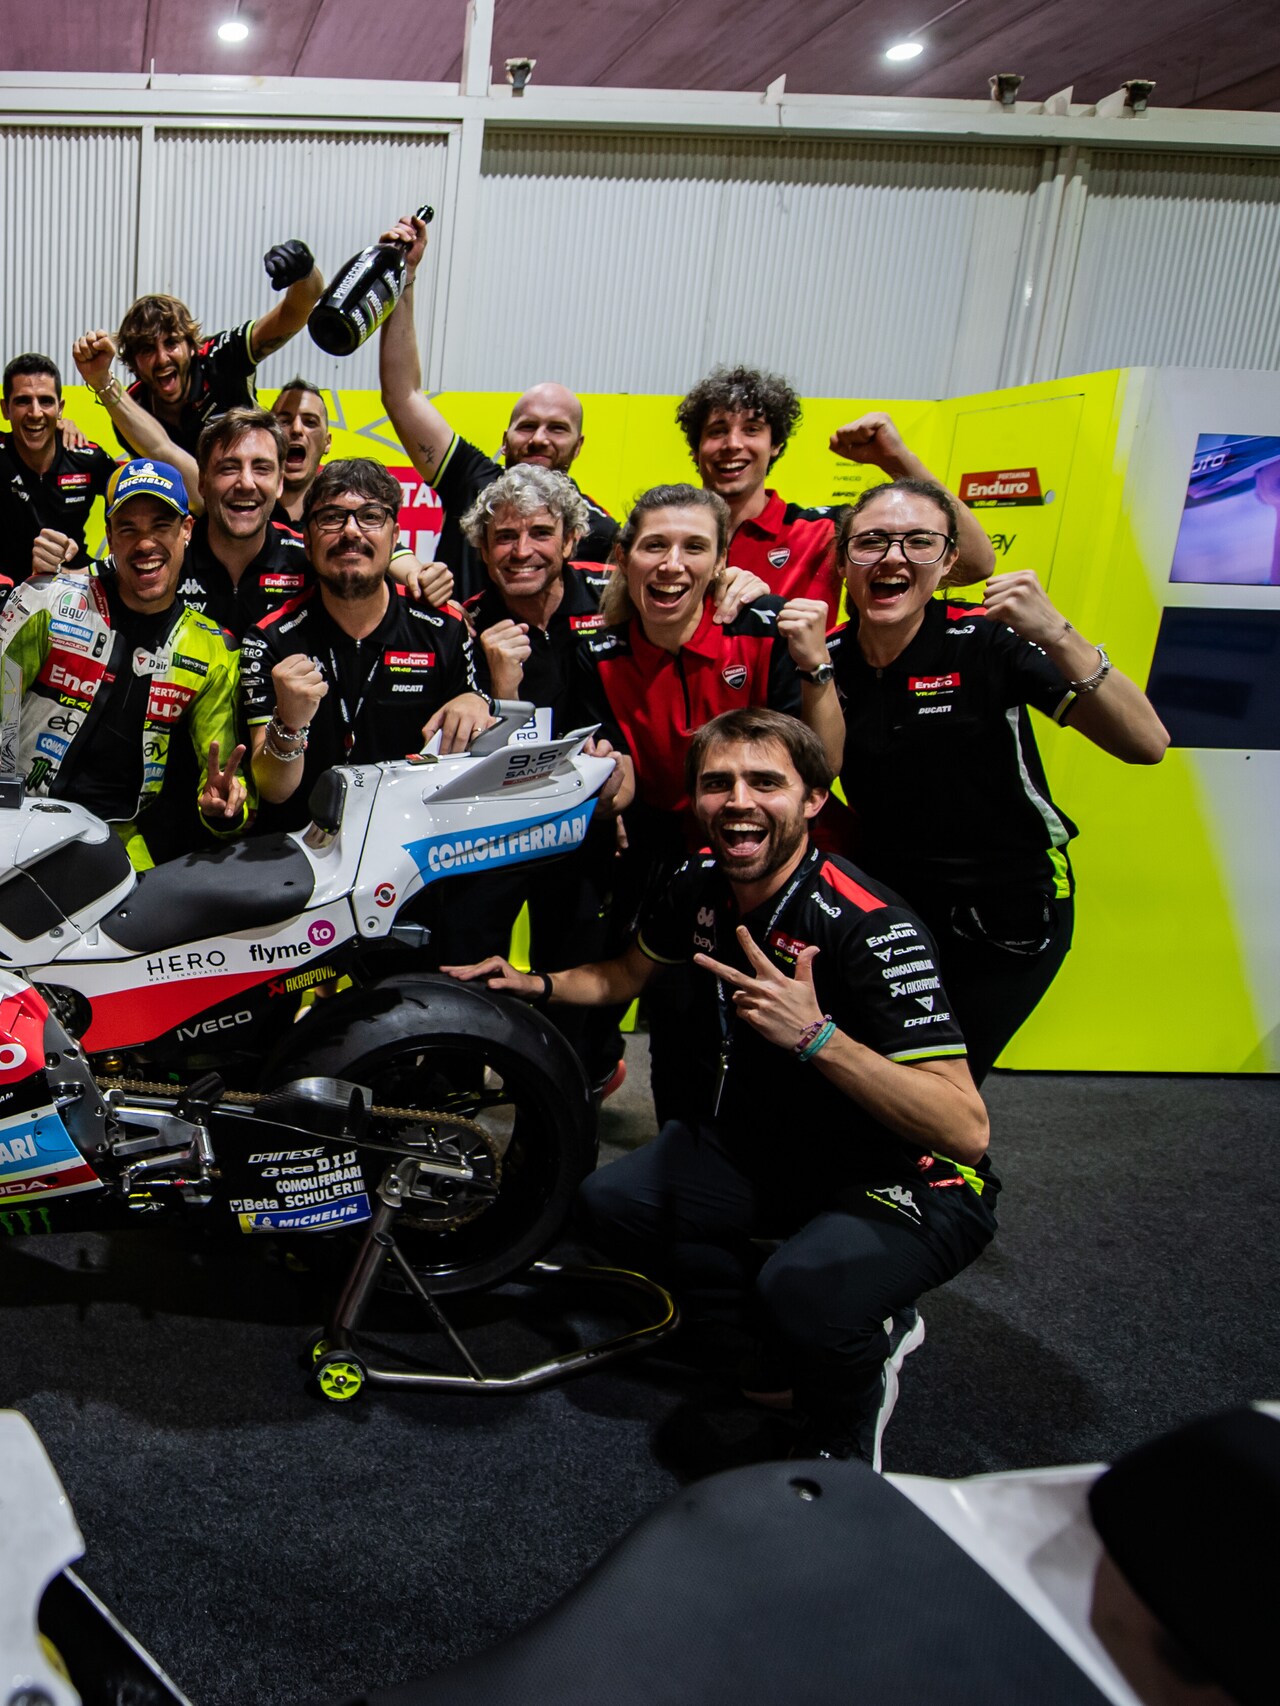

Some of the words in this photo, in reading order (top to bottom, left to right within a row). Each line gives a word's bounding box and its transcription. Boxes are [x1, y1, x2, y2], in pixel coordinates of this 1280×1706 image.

[118, 477, 173, 491] MICHELIN
[967, 480, 1029, 497] Enduro
[991, 533, 1017, 555] ay
[264, 577, 300, 587] Enduro
[61, 605, 84, 620] agv
[184, 599, 207, 613] bay
[390, 655, 429, 665] Enduro
[391, 684, 424, 693] DUCATI
[918, 705, 952, 715] DUCATI
[428, 836, 507, 872] COMOLI
[509, 814, 587, 855] FERRARI
[311, 926, 332, 942] to
[693, 931, 715, 952] bay
[866, 928, 918, 948] Enduro
[249, 941, 312, 964] flyme
[893, 945, 926, 956] CUPRA
[147, 950, 226, 976] HERO
[882, 963, 912, 979] COMOLI
[176, 968, 229, 978] INNOVATION
[176, 1010, 253, 1042] IVECO
[903, 1012, 951, 1028] DAINESE
[248, 1146, 325, 1164] DAINESE
[281, 1165, 315, 1176] RCB
[276, 1177, 318, 1194] COMOLI
[319, 1165, 362, 1188] FERRARI
[284, 1184, 353, 1208] SCHULER
[243, 1197, 279, 1212] Beta
[278, 1203, 358, 1228] MICHELIN
